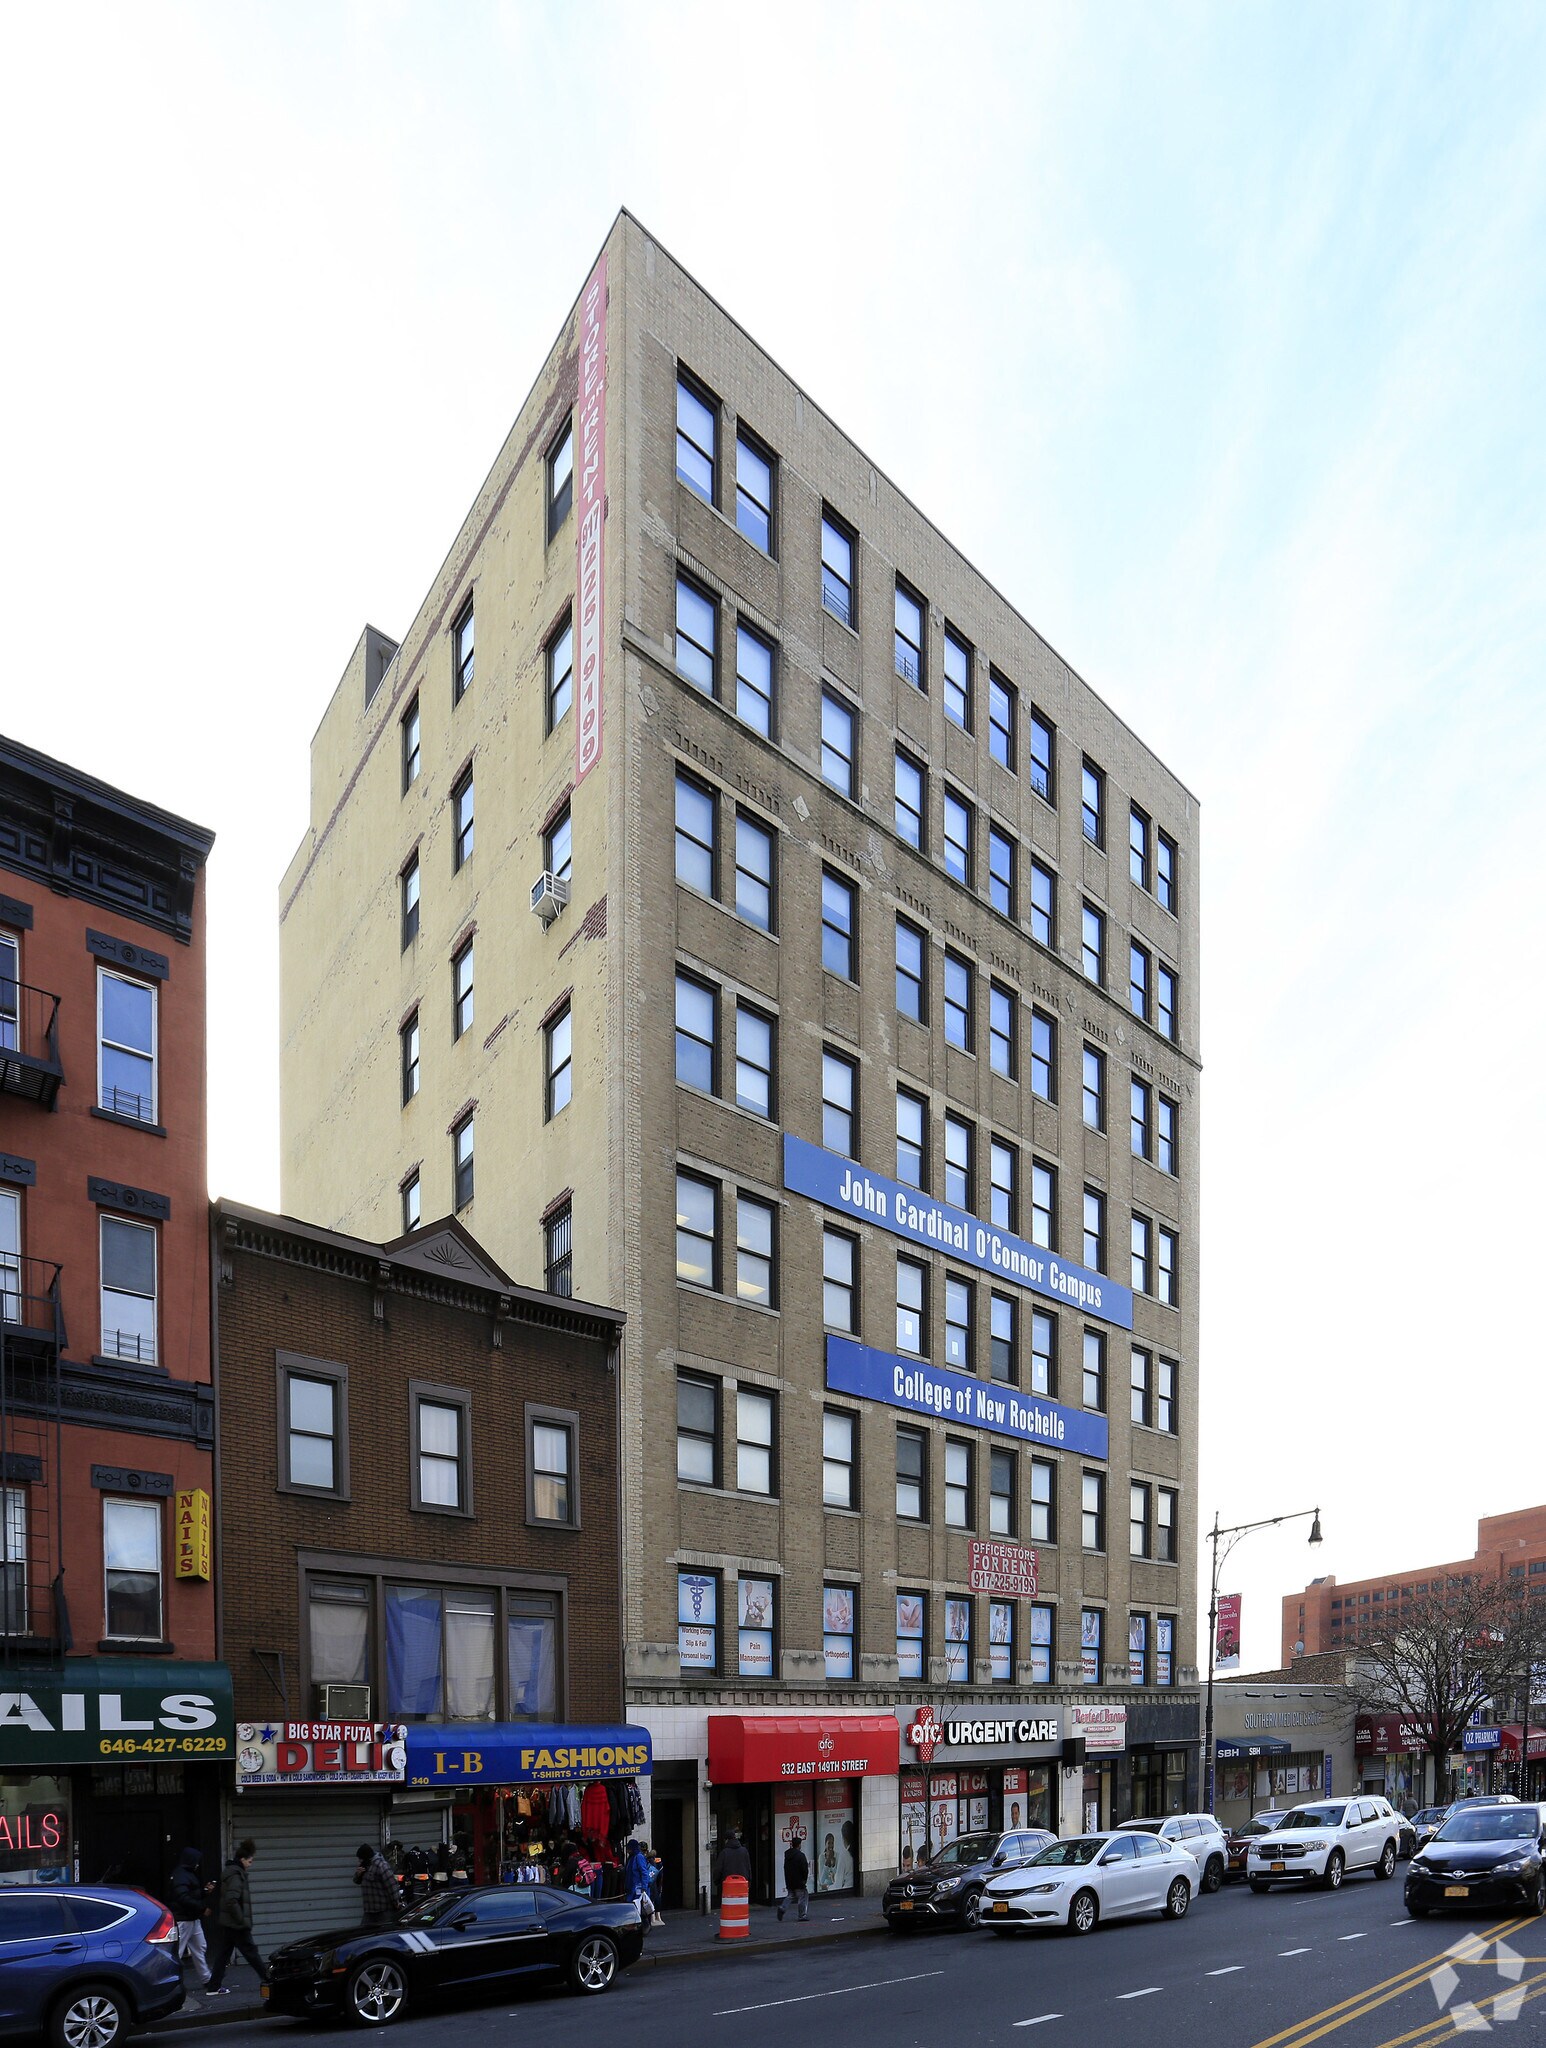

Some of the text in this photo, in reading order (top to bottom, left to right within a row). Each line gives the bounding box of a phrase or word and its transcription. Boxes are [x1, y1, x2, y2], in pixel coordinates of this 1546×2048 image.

[584, 281, 600, 399] STORE
[580, 379, 604, 424] FOR
[582, 406, 600, 504] RENT
[581, 503, 600, 549] 917
[839, 1169, 1103, 1309] John Cardinal O'Connor Campus
[892, 1365, 1066, 1441] College of New Rochelle
[179, 1494, 194, 1573] NAILS
[972, 1541, 1036, 1562] OFFICE/STORE
[973, 1571, 1035, 1594] 917-225-9199
[1218, 1610, 1238, 1620] Lincoln
[681, 1626, 713, 1636] Working Comp
[685, 1639, 695, 1648] Slip
[749, 1642, 761, 1650] Pain
[680, 1651, 712, 1661] Personal Injury
[739, 1653, 771, 1664] Management
[824, 1650, 850, 1660] Orthopedist
[0, 1692, 218, 1731] AILS
[1072, 1708, 1102, 1724] Perfect
[1245, 1712, 1277, 1729] SOUTHERN
[288, 1723, 372, 1742] BIG STAR FUTA
[911, 1715, 943, 1744] afc
[948, 1720, 1058, 1744] URGENT CARE
[1465, 1730, 1499, 1744] OZ PHARMACY
[99, 1737, 227, 1754] 646-427-6229
[818, 1737, 834, 1750] afc
[1248, 1746, 1261, 1756] SBH
[276, 1742, 383, 1773] DELI
[520, 1745, 649, 1770] FASHIONS
[1217, 1748, 1239, 1758] SBH
[432, 1751, 484, 1775] I-B
[781, 1759, 868, 1775] 332 EAST 149TH STREET
[411, 1776, 430, 1785] 340
[531, 1766, 641, 1779] T-SHIRTS CAPS & MORE
[1003, 1774, 1019, 1790] RE
[0, 1813, 60, 1850] AILS
[782, 1822, 807, 1841] afc
